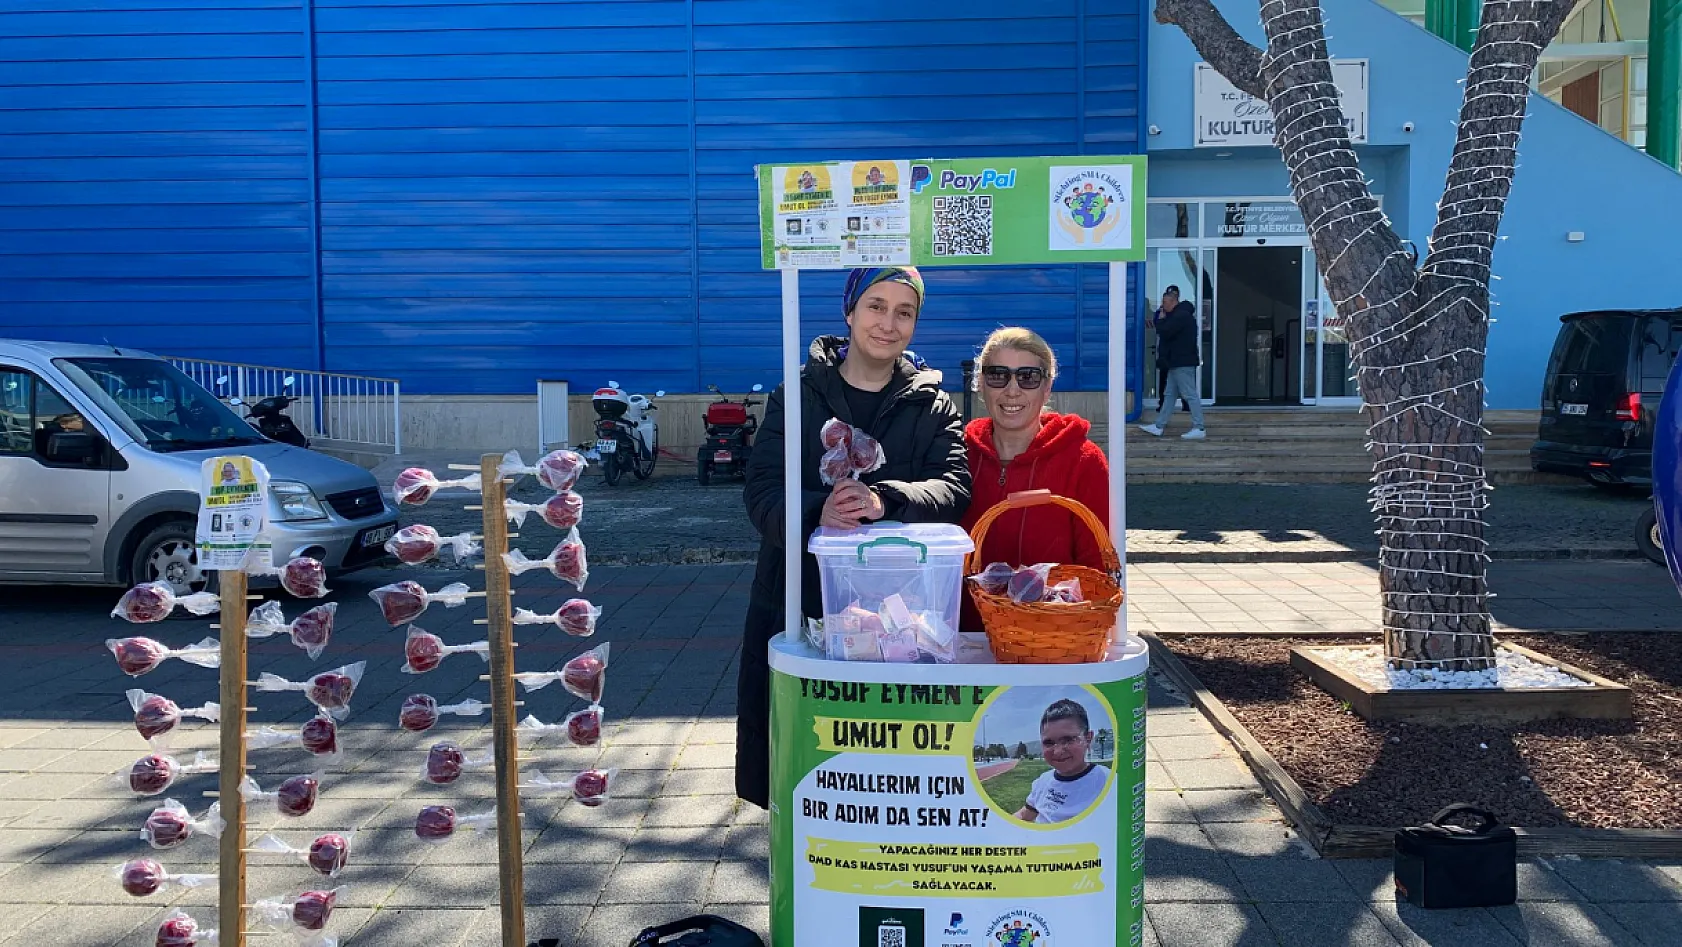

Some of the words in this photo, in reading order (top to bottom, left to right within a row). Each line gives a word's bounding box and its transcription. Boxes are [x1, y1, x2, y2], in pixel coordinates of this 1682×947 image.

[1220, 92, 1239, 100] T.C.
[940, 169, 1016, 192] PayPal
[1053, 173, 1082, 203] Stichting
[1081, 170, 1099, 180] SMA
[1100, 173, 1126, 203] Children
[800, 677, 870, 704] YUSUF
[833, 720, 903, 750] UMUT
[912, 723, 955, 751] OL!
[816, 770, 921, 795] HAYALLERIM
[803, 797, 829, 820] BIR
[835, 803, 880, 825] ADIM
[886, 807, 910, 827] DA
[917, 808, 951, 827] SEN
[957, 808, 990, 828] AT!
[880, 844, 958, 856] YAPACAĞINIZ
[961, 847, 983, 856] HER
[985, 847, 1027, 857] DESTEK
[808, 854, 832, 866] DMD
[835, 858, 858, 869] KAS
[860, 861, 909, 872] HASTASI
[912, 863, 968, 873] YUSUF'UN
[971, 864, 1023, 875] YAŞAMA
[1026, 858, 1102, 873] TUTUNMASINI
[912, 878, 997, 891] SAĞLAYACAK.
[943, 928, 969, 937] PayPal
[985, 912, 1011, 937] Stichting
[1011, 909, 1027, 918] SMA
[1028, 911, 1051, 937] Children
